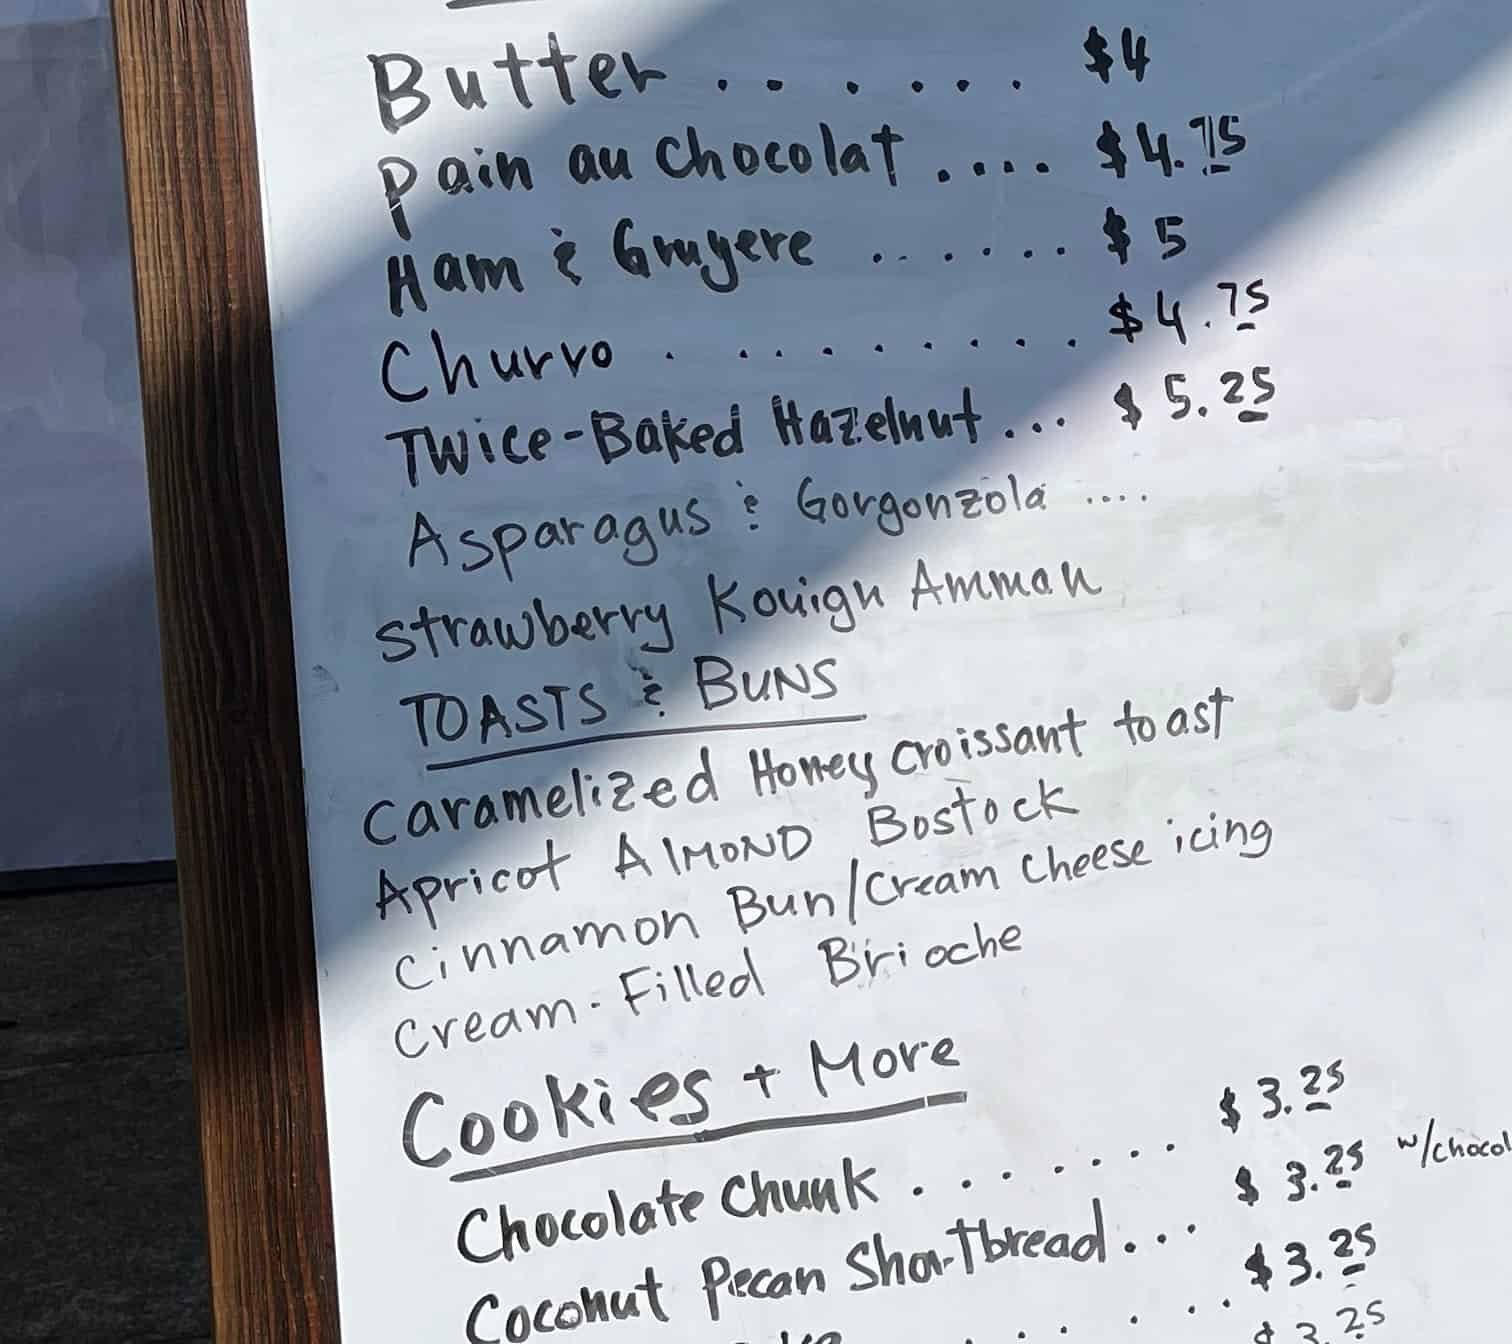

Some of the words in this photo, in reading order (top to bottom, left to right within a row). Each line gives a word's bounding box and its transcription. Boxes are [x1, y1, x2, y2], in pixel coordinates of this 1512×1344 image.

[367, 32, 666, 134] Butter
[1084, 26, 1150, 83] $4
[569, 143, 633, 184] au
[387, 253, 524, 317] Ham
[614, 218, 813, 293] Gruyere
[772, 387, 982, 446] Hazelnut
[409, 498, 710, 582] Asparagus
[798, 474, 1047, 536] Gorgonzola
[911, 559, 1102, 611] Amman
[400, 683, 607, 746] TOASTS
[694, 655, 838, 710] BUNS
[749, 747, 878, 799] Honey
[1114, 687, 1234, 746] toast
[376, 839, 572, 930] Apricot
[867, 779, 1080, 847] Bostock
[1167, 811, 1273, 858] icing
[818, 922, 1022, 987] Brioche
[403, 1068, 711, 1168] Cookies
[744, 1064, 781, 1098] +
[810, 1036, 960, 1097] More
[457, 1179, 704, 1263] Chocolate
[702, 1255, 826, 1321] Pecan
[846, 1198, 1107, 1291] Shortbread
